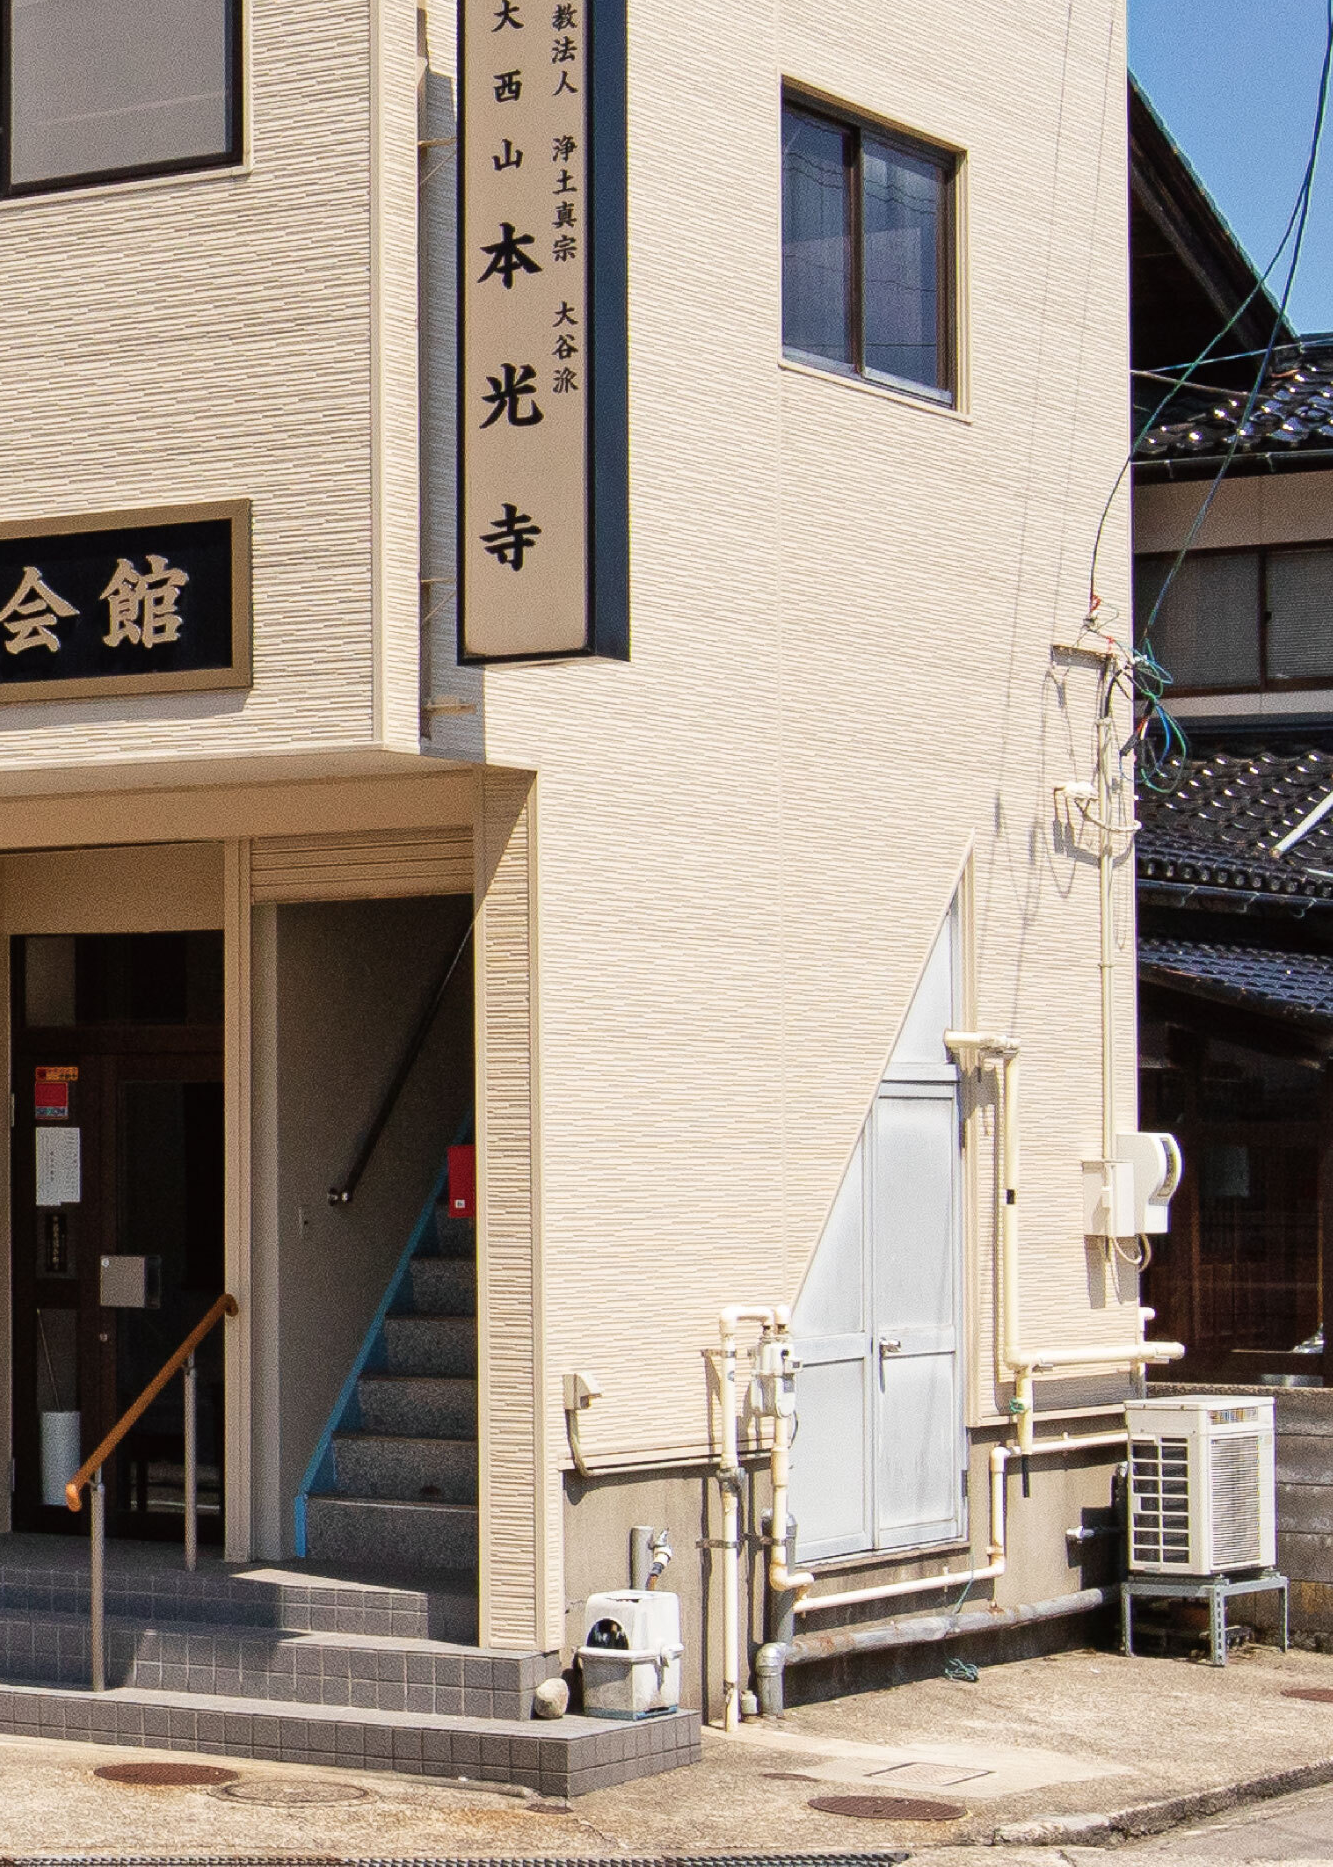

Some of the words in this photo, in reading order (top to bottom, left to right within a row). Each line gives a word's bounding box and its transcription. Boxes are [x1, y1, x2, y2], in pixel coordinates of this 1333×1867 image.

[551, 134, 579, 263] 浄土真宗
[476, 220, 545, 573] 本光寺
